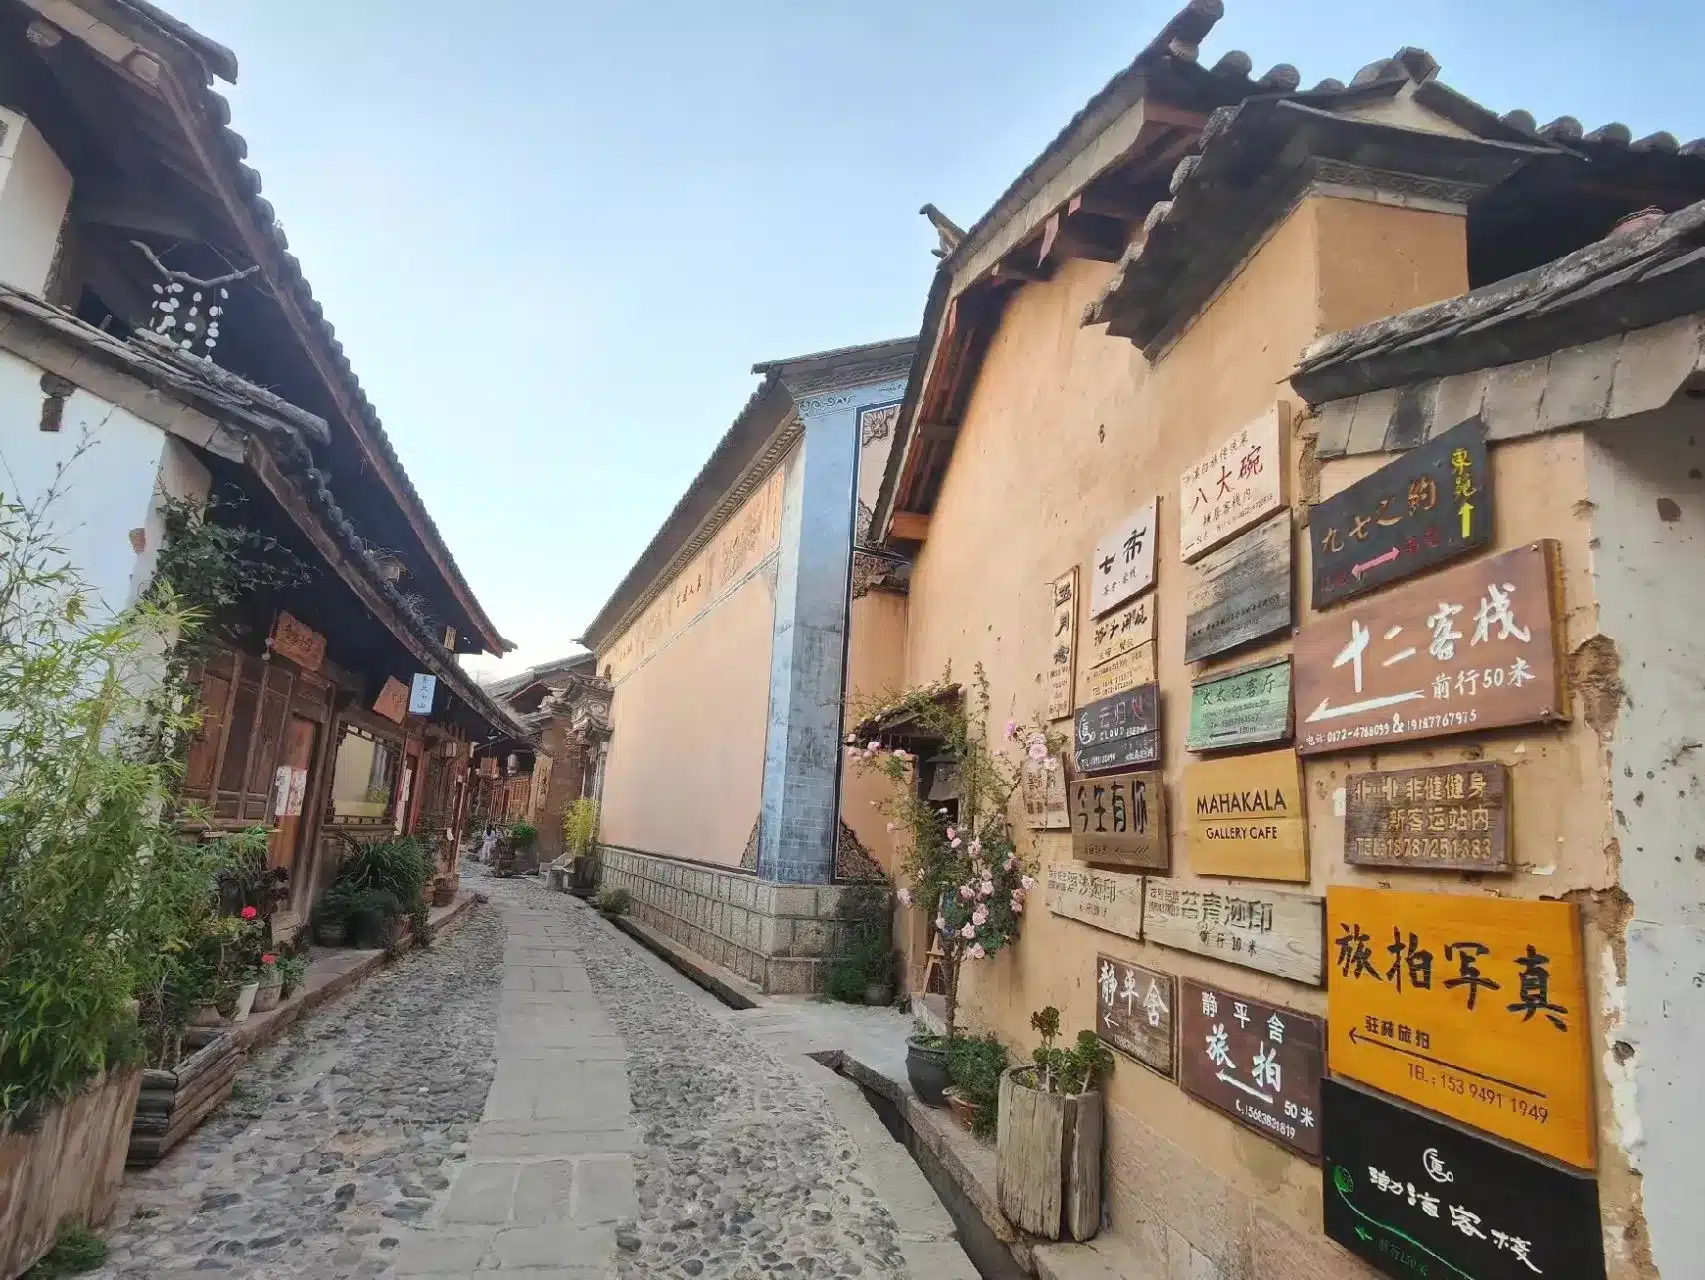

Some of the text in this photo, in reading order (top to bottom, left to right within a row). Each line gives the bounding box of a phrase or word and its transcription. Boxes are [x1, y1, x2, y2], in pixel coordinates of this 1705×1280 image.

[1190, 445, 1264, 514] 八大碗
[1332, 582, 1531, 692] 十二客栈
[1431, 656, 1536, 702] 前行50米
[1197, 787, 1287, 815] MAHAKALA
[1389, 805, 1490, 833] 新客运站内
[1206, 826, 1278, 840] GALLERY CAFE
[1336, 922, 1568, 1033] 旅拍写真
[1202, 991, 1285, 1044] 静平舍
[1205, 1023, 1281, 1093] 旅拍
[1284, 1100, 1315, 1128] 50米
[1440, 1073, 1465, 1096] 153
[1468, 1083, 1504, 1109] 9491
[1510, 1097, 1549, 1125] 1949
